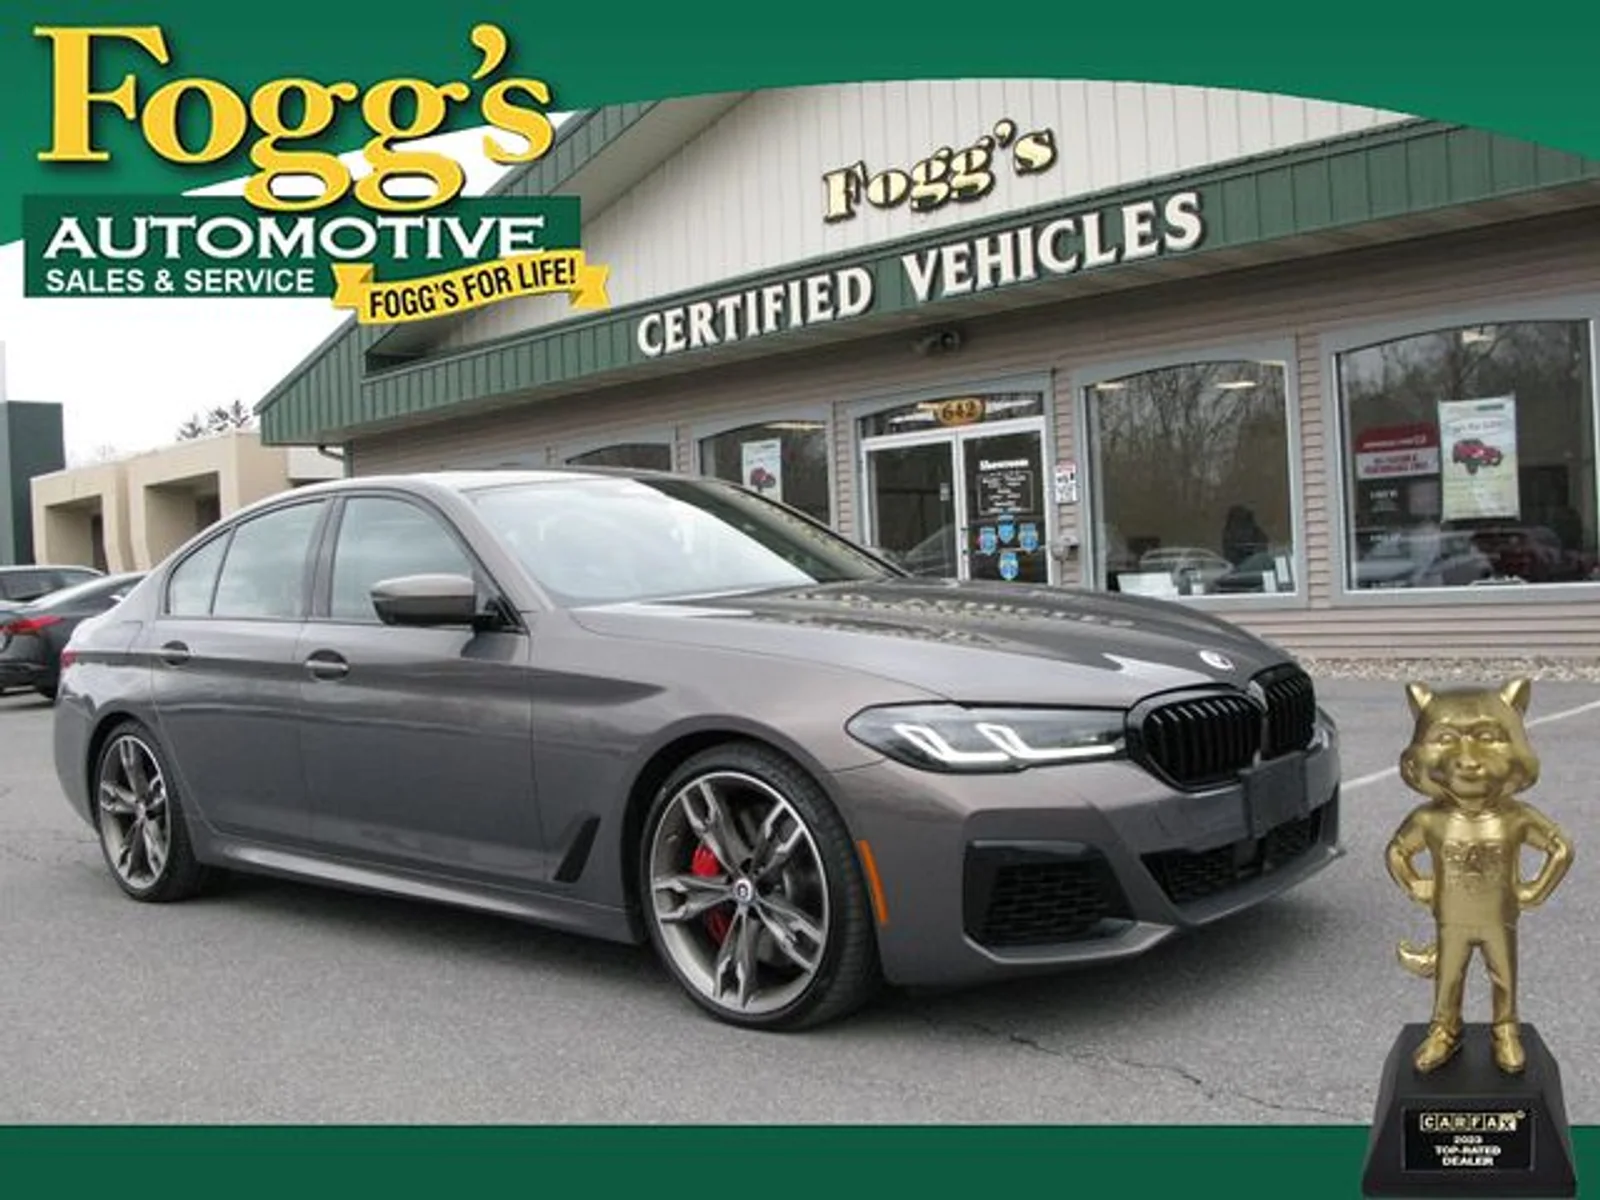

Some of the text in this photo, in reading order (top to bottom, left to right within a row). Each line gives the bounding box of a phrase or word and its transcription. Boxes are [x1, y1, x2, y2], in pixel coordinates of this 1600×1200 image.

[822, 119, 1057, 222] Fogg's
[637, 191, 1206, 358] CERTIFIED VEHICLES
